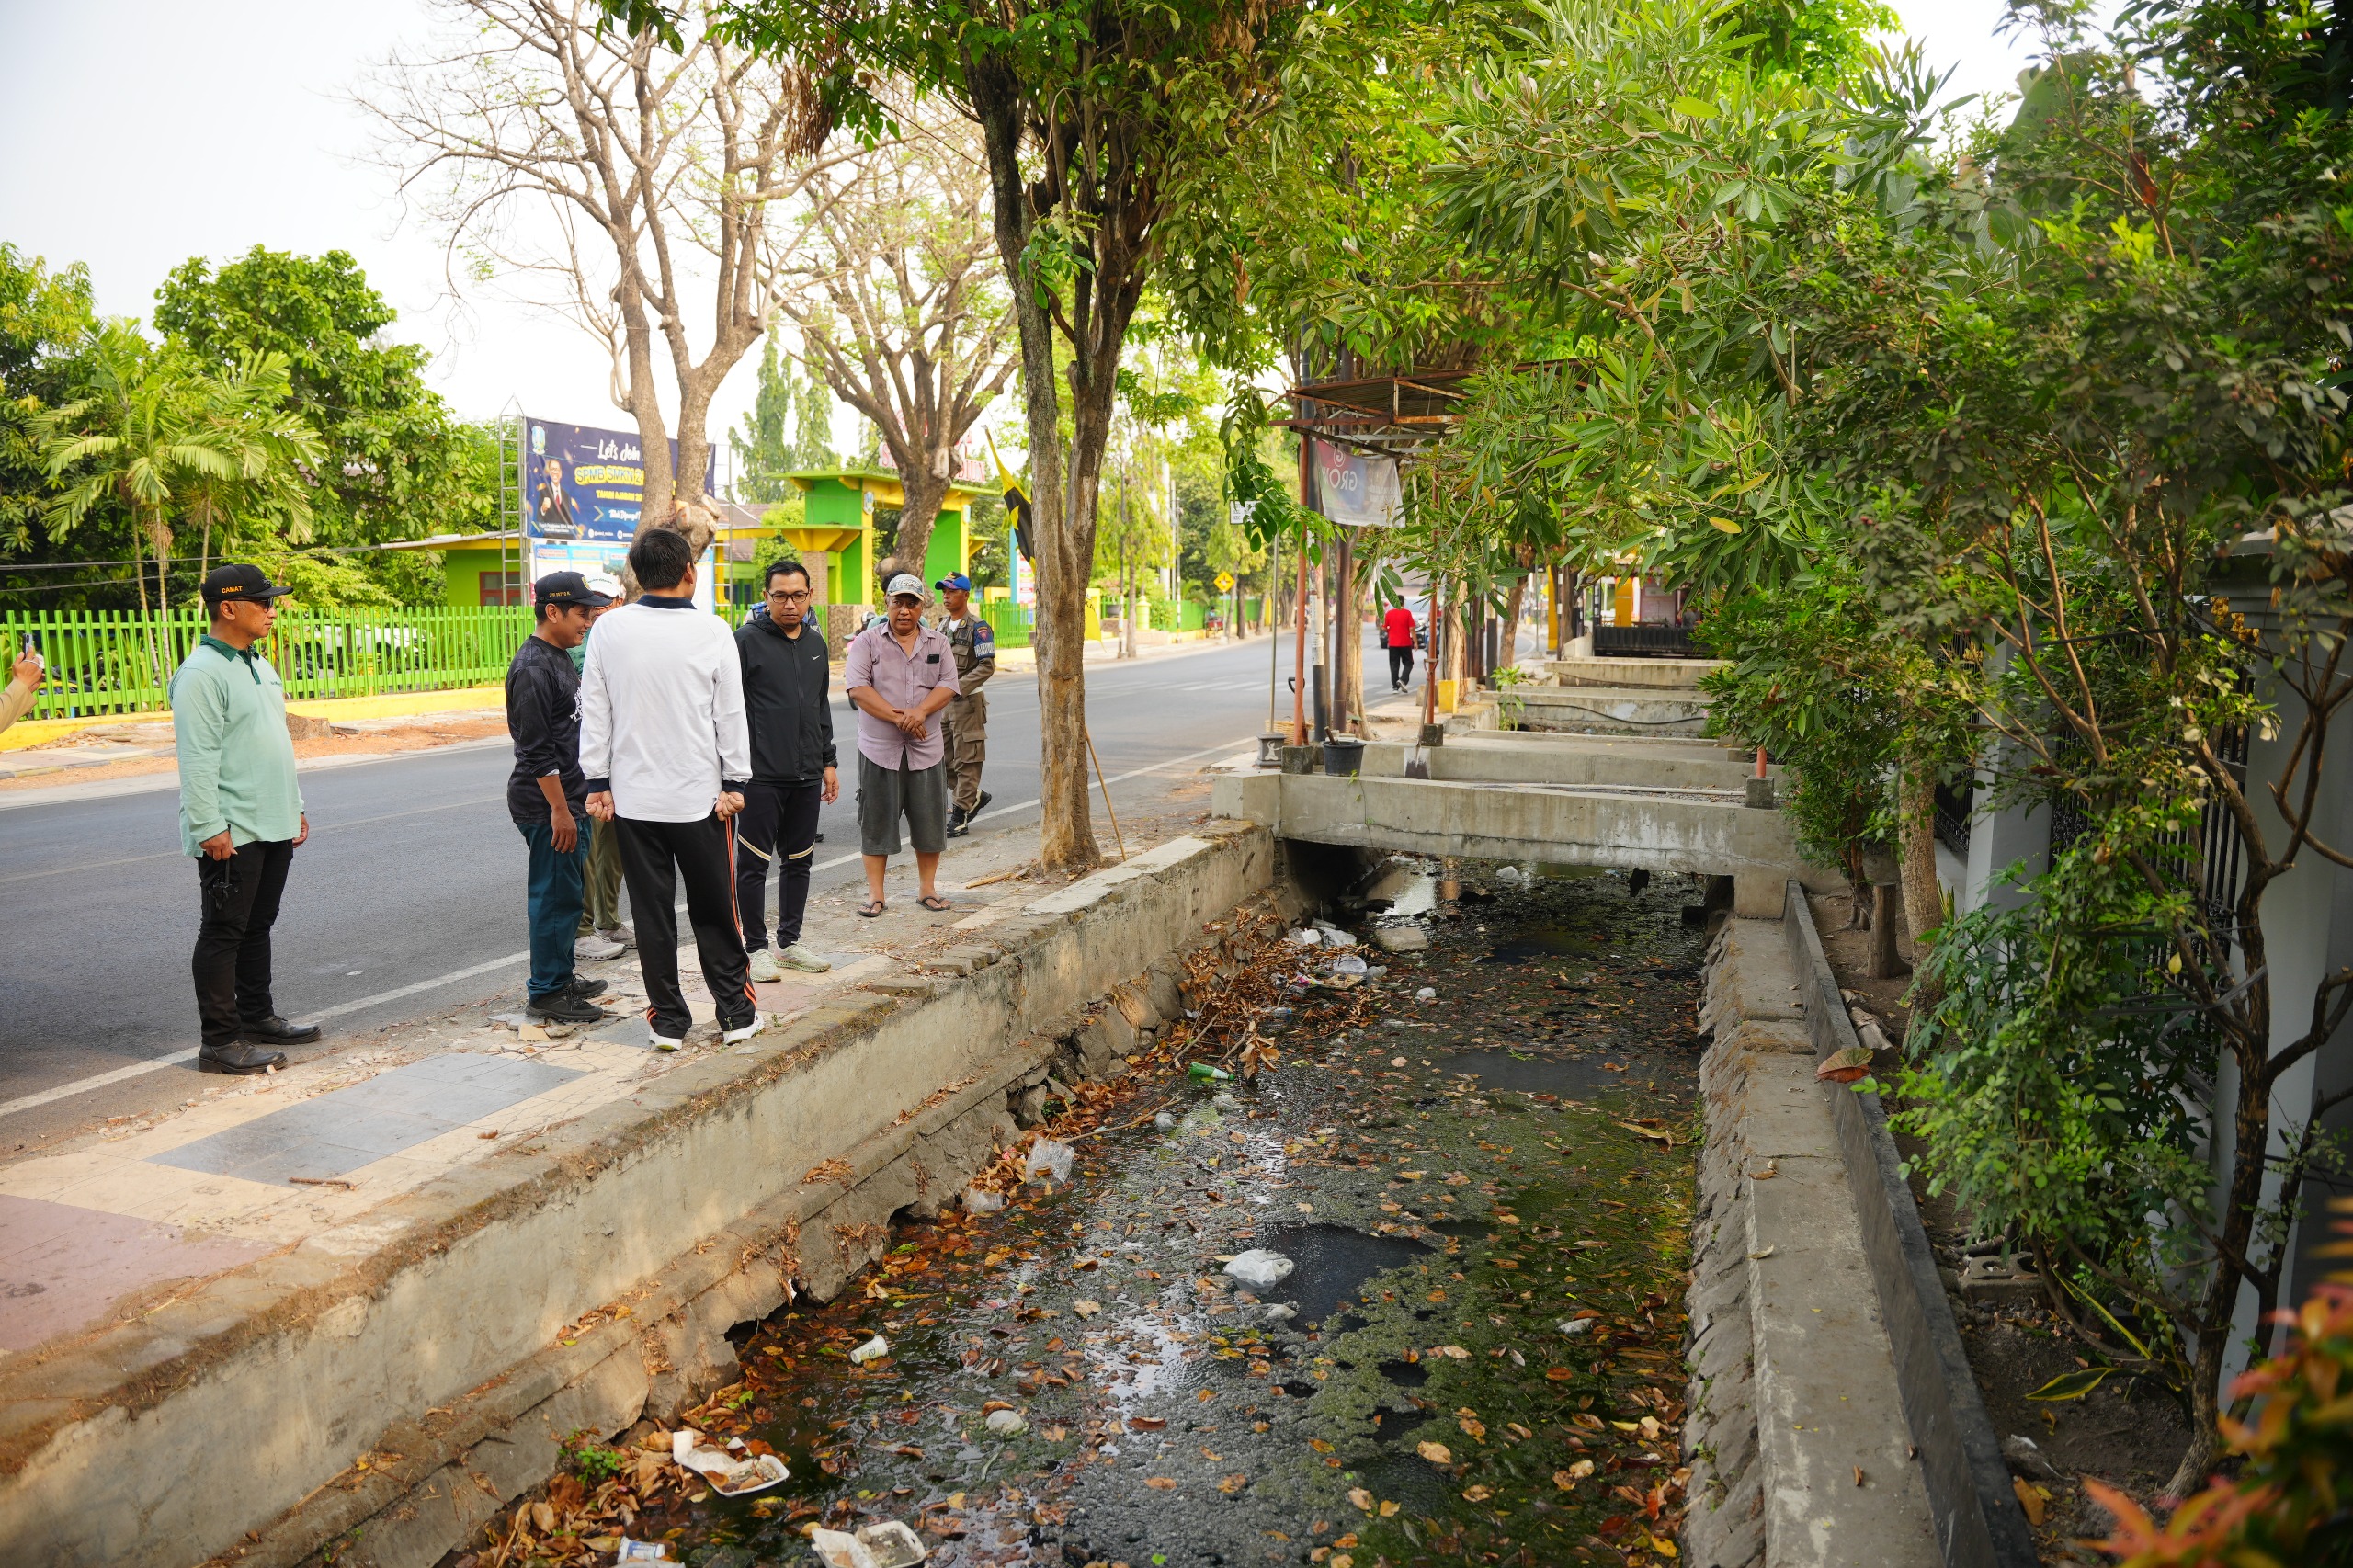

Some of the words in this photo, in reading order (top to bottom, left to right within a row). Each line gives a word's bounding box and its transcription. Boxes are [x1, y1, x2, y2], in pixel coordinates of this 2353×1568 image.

[575, 466, 606, 483] SPMB
[606, 466, 634, 483] SMKN
[222, 585, 243, 594] CAMAT
